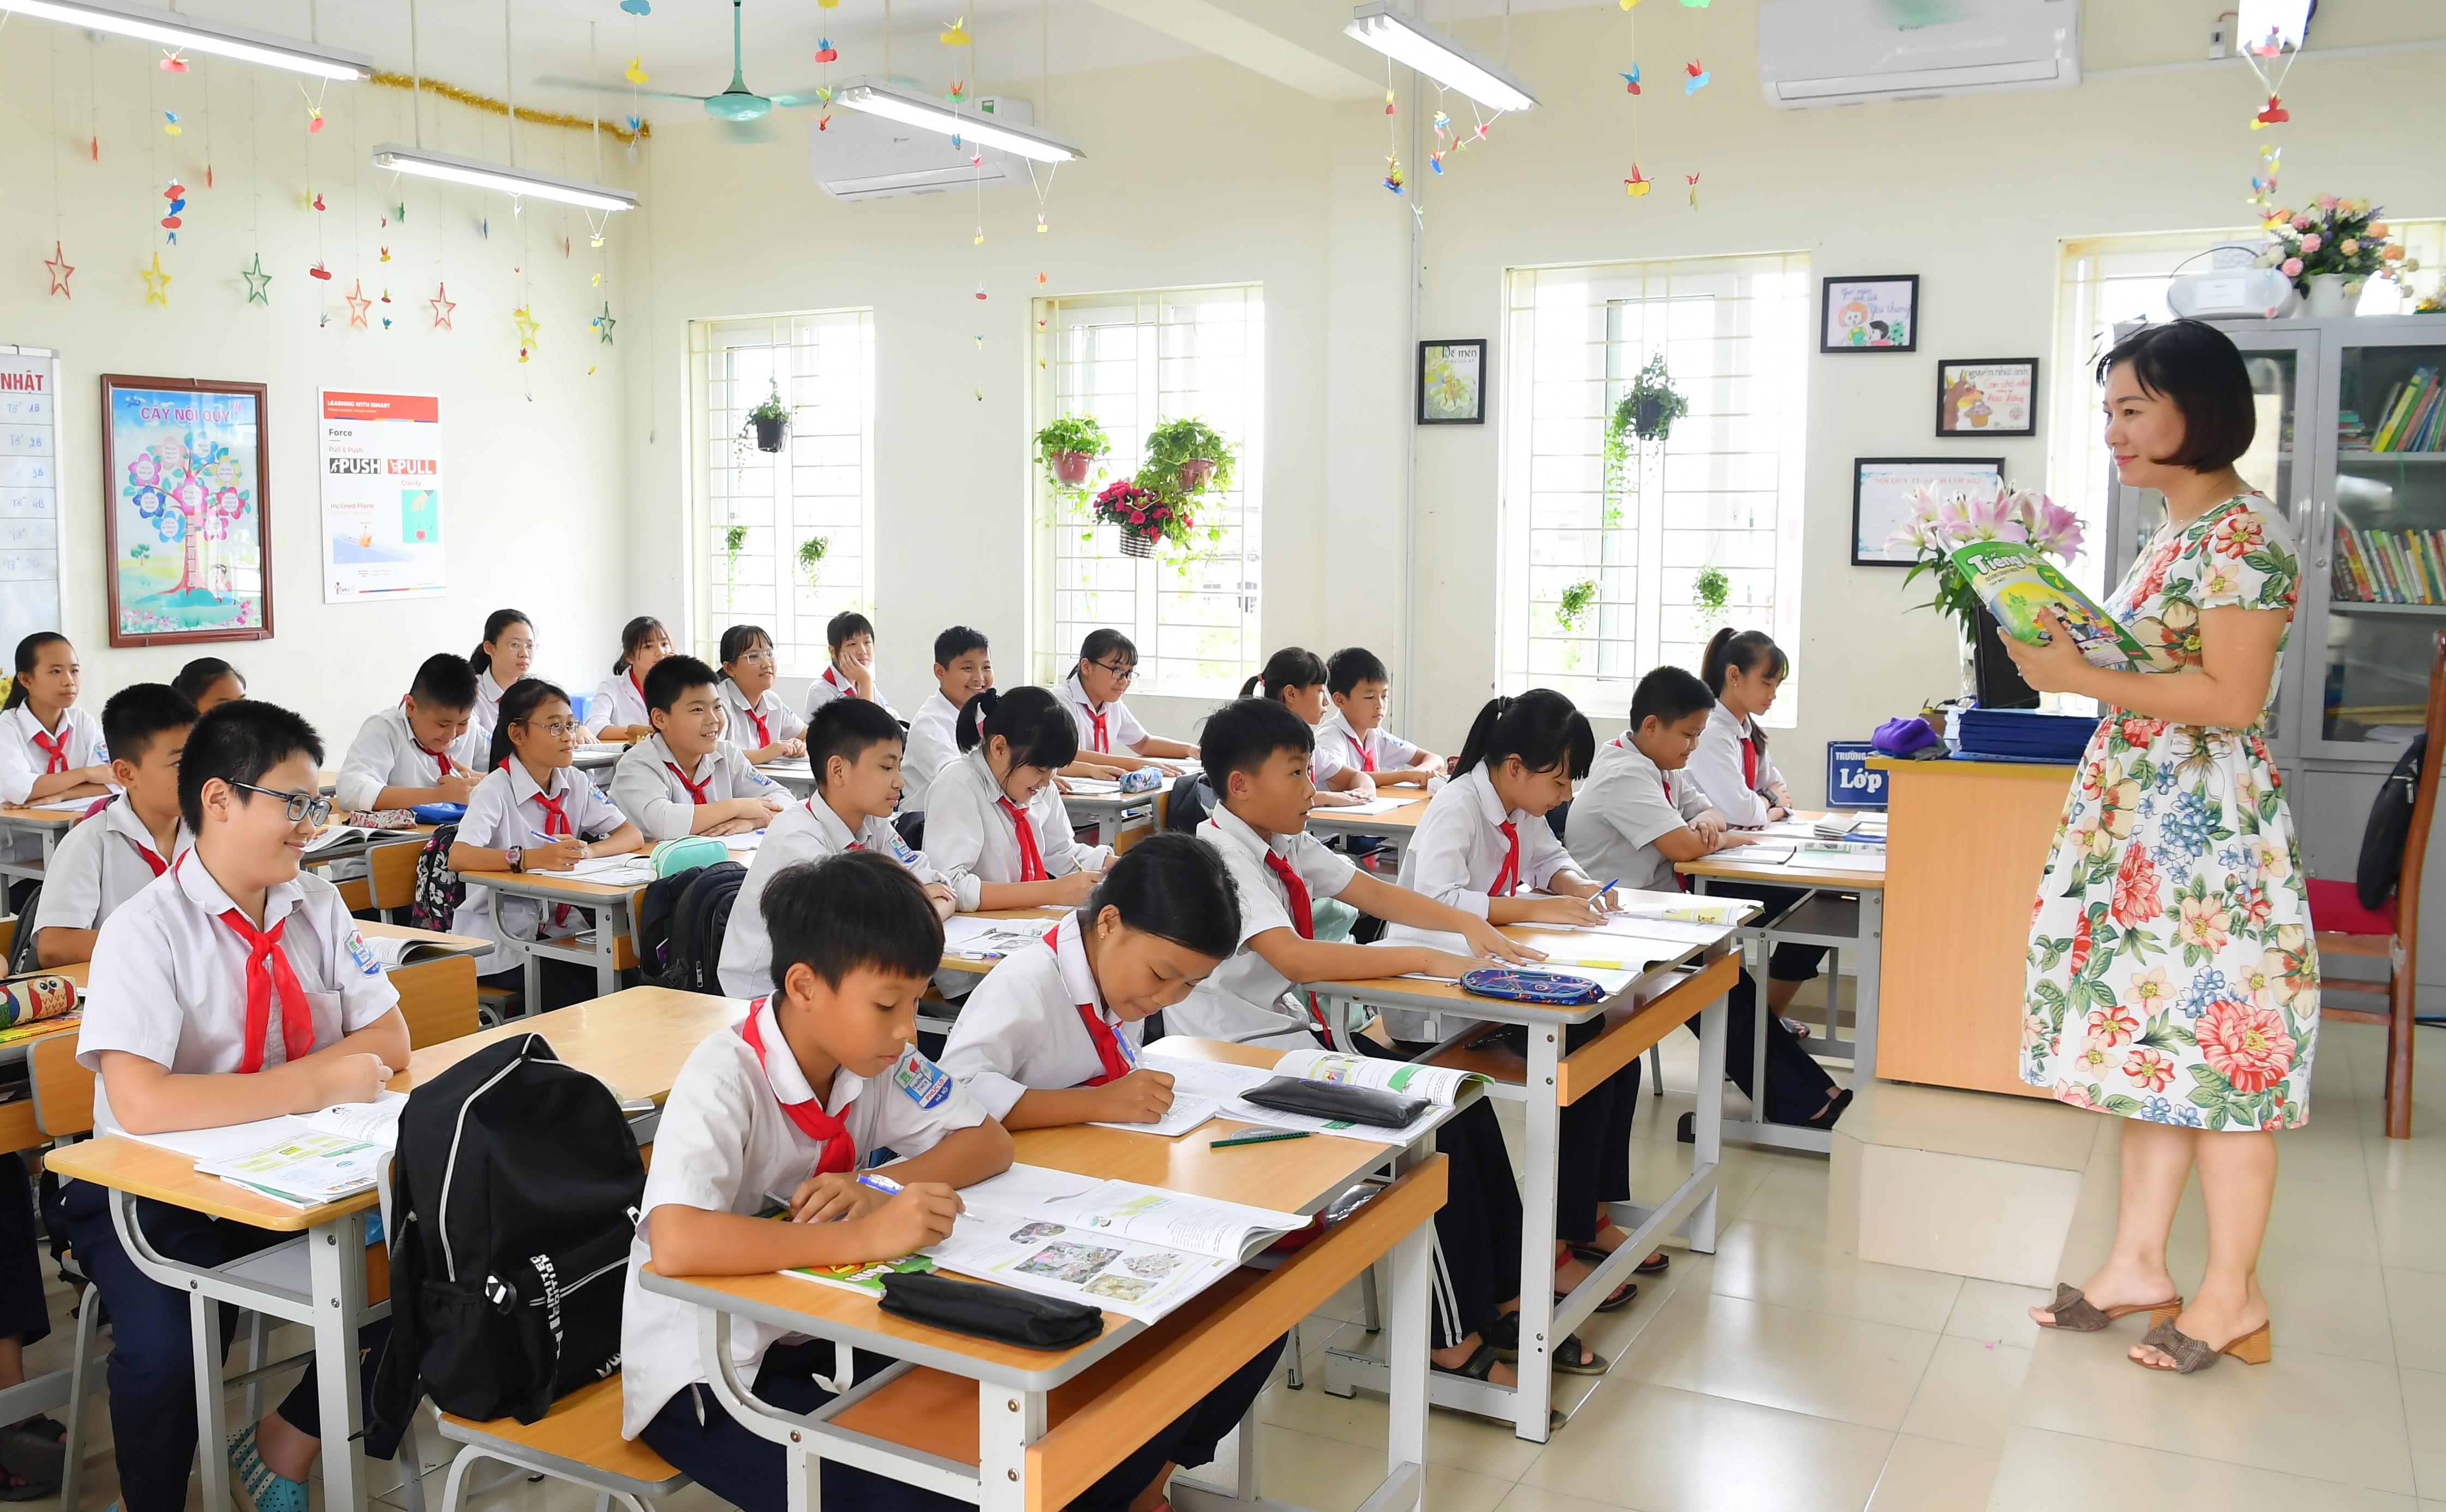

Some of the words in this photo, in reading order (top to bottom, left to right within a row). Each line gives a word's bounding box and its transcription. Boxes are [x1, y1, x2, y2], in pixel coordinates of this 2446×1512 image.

[1, 370, 44, 394] NHẬT
[141, 405, 170, 420] CÂY
[175, 406, 198, 425] NỘI
[329, 428, 353, 437] Force
[339, 458, 381, 474] PUSH
[397, 459, 433, 474] PULL
[1967, 552, 2026, 575] Tiếng
[2043, 571, 2066, 589] 7
[1835, 750, 1866, 761] TRƯỜNG
[1840, 768, 1882, 793] Lớp
[926, 1085, 939, 1101] PHÚC
